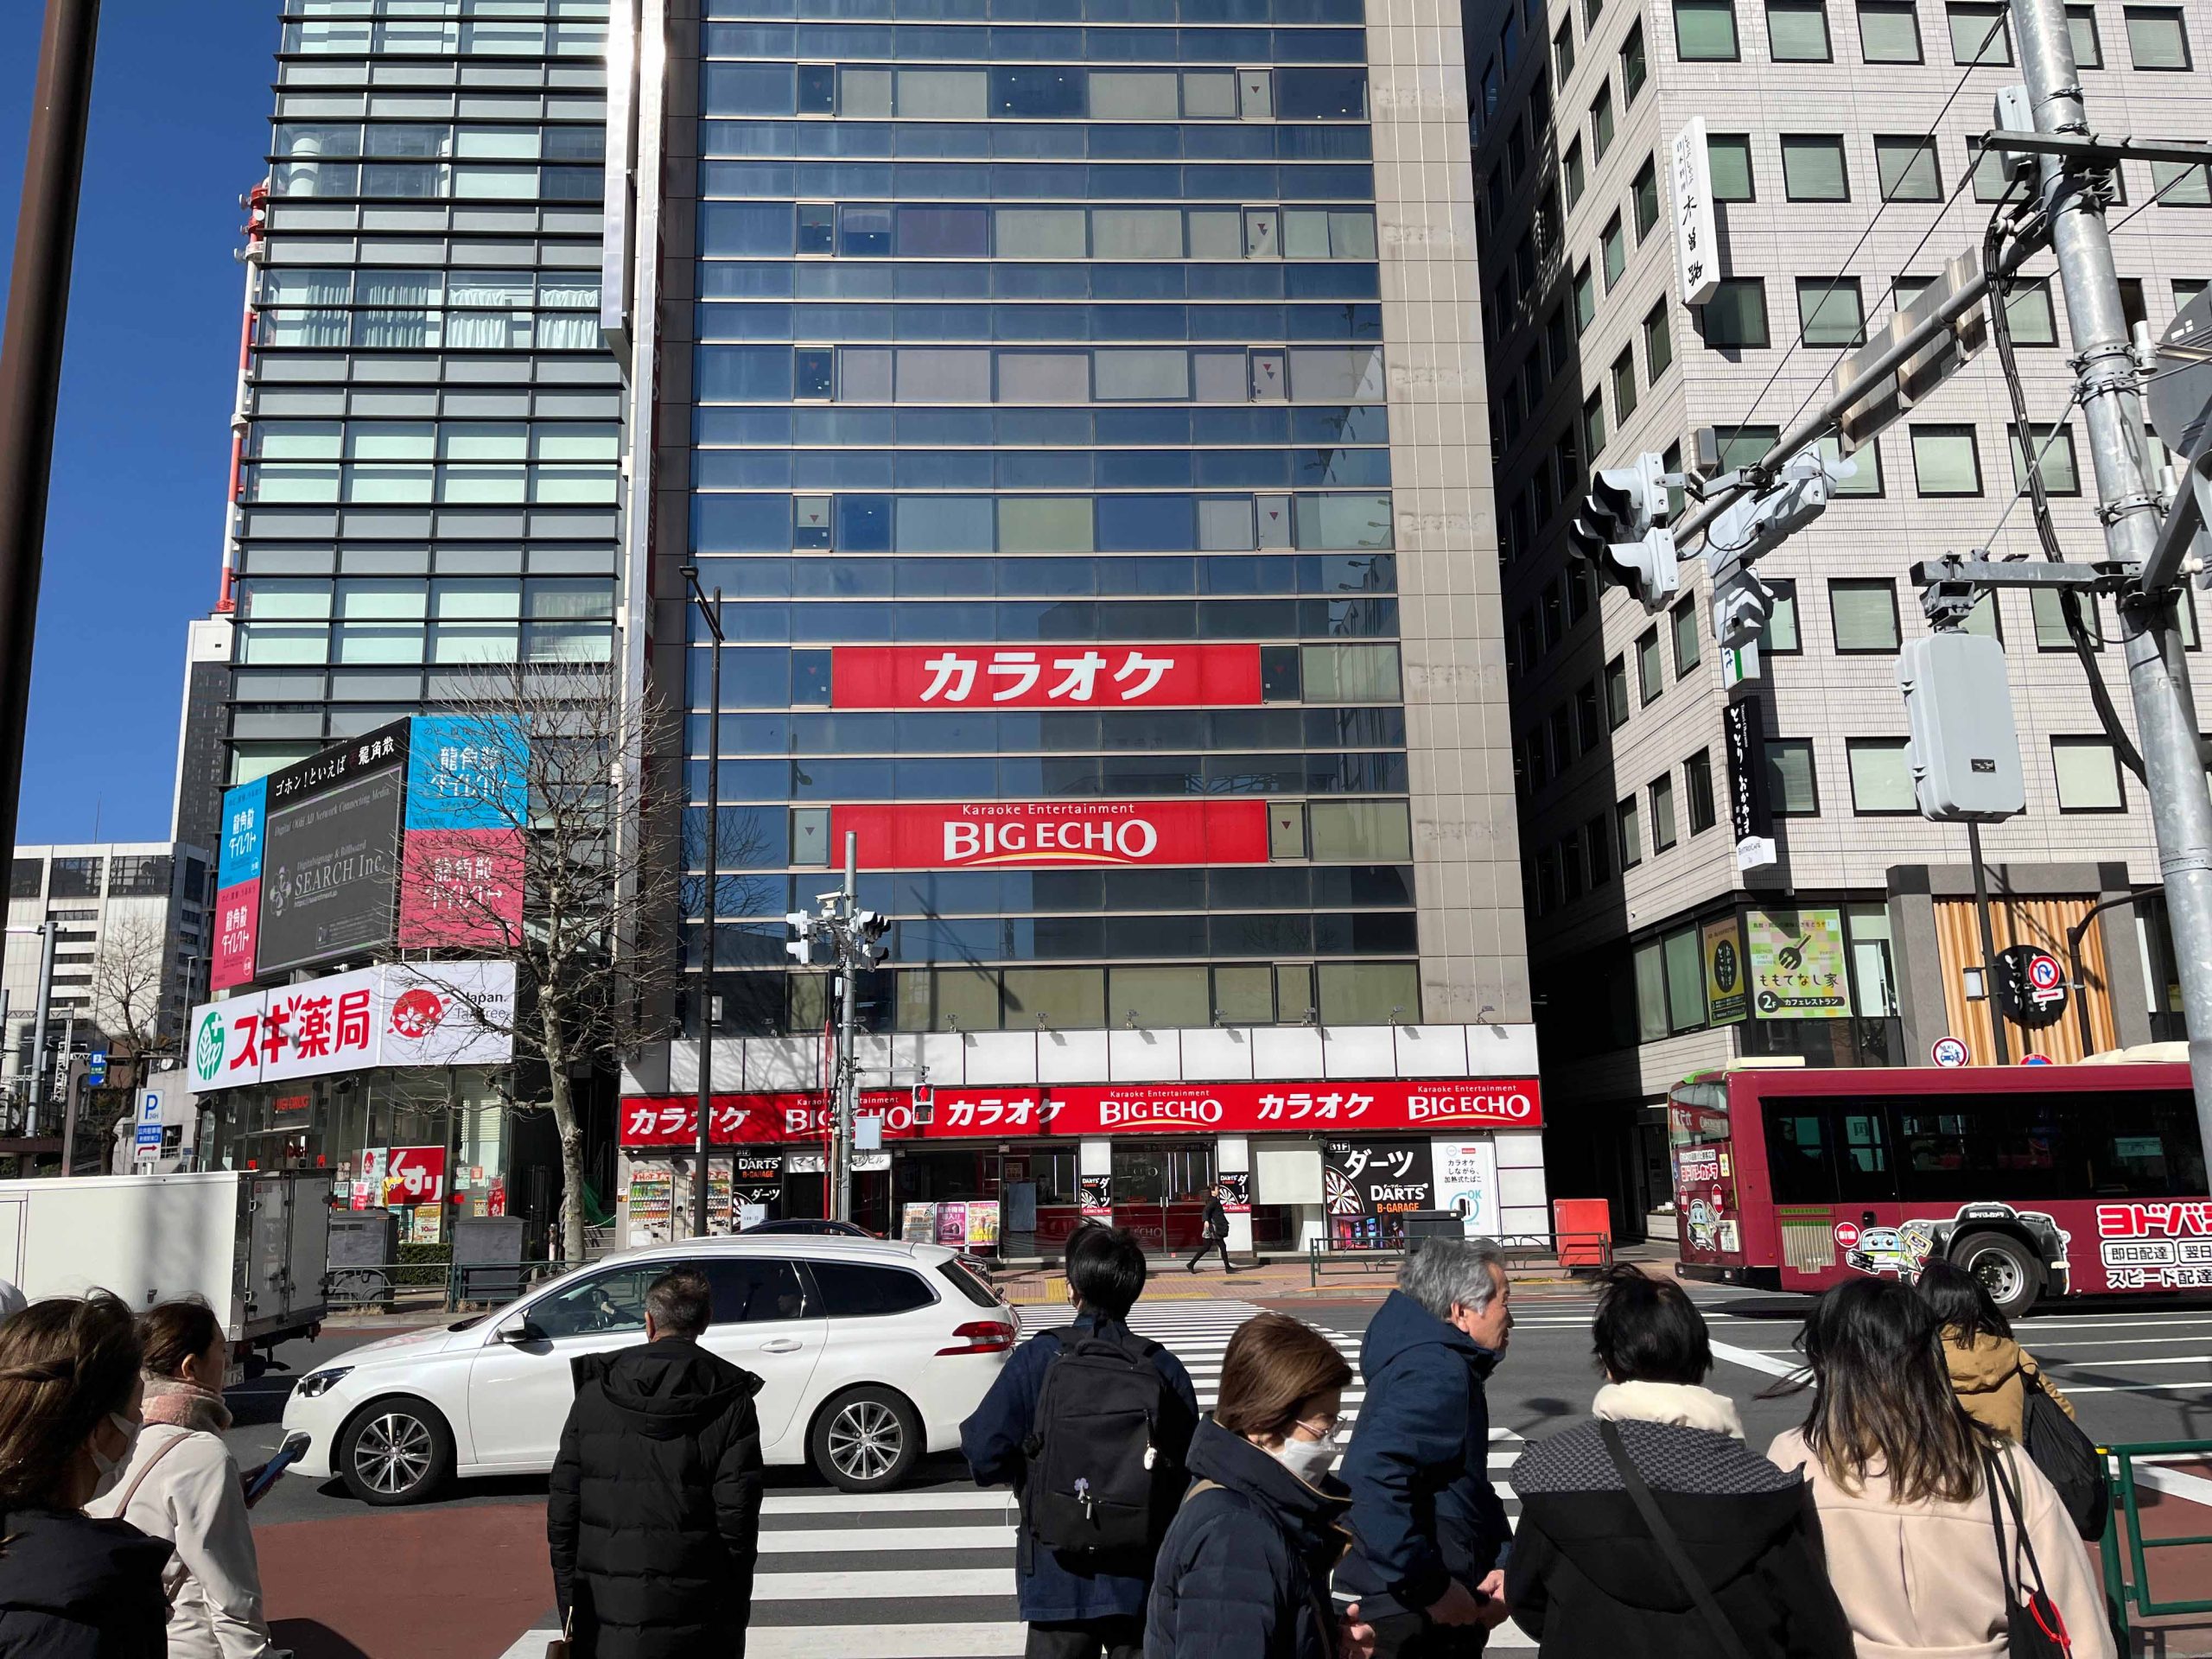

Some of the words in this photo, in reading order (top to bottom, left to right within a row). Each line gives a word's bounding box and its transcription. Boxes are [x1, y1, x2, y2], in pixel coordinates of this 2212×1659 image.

[919, 652, 1174, 702] カラオケ
[358, 736, 395, 766] 龍角散
[963, 804, 1021, 816] Karaoke
[1028, 803, 1135, 815] Entertainment
[944, 820, 1026, 861] BIG
[1035, 818, 1157, 858] ECHO
[295, 858, 353, 897] SEARCH
[359, 855, 385, 877] Inc.
[1759, 973, 1840, 988] ももてなし家
[1784, 998, 1839, 1007] カフェレストラン
[230, 988, 370, 1071] スギ薬局
[1110, 1090, 1145, 1098] Karaoke
[1147, 1089, 1210, 1097] Entertainment
[1418, 1085, 1452, 1094] Karaoke
[1454, 1084, 1517, 1093] Entertainment
[145, 1095, 158, 1119] P
[946, 1096, 1065, 1127] カラオケ
[1100, 1102, 1149, 1125] BIG
[1153, 1099, 1223, 1122] ECHO
[1257, 1092, 1374, 1120] カラオケ
[1408, 1096, 1457, 1122] BIG
[1460, 1093, 1530, 1117] ECHO
[390, 1152, 443, 1200] くすり
[739, 1157, 779, 1170] DARTS
[1344, 1147, 1414, 1180] ダーツ
[751, 1187, 780, 1201] ダーツ
[1099, 1177, 1110, 1207] ダーツ
[1237, 1174, 1249, 1204] ダーツ
[1370, 1185, 1425, 1201] DARTS
[1467, 1190, 1483, 1199] OK
[1376, 1203, 1420, 1213] B-GARAGE
[2112, 1246, 2168, 1261] 即日配達
[2108, 1268, 2212, 1286] スピード配達
